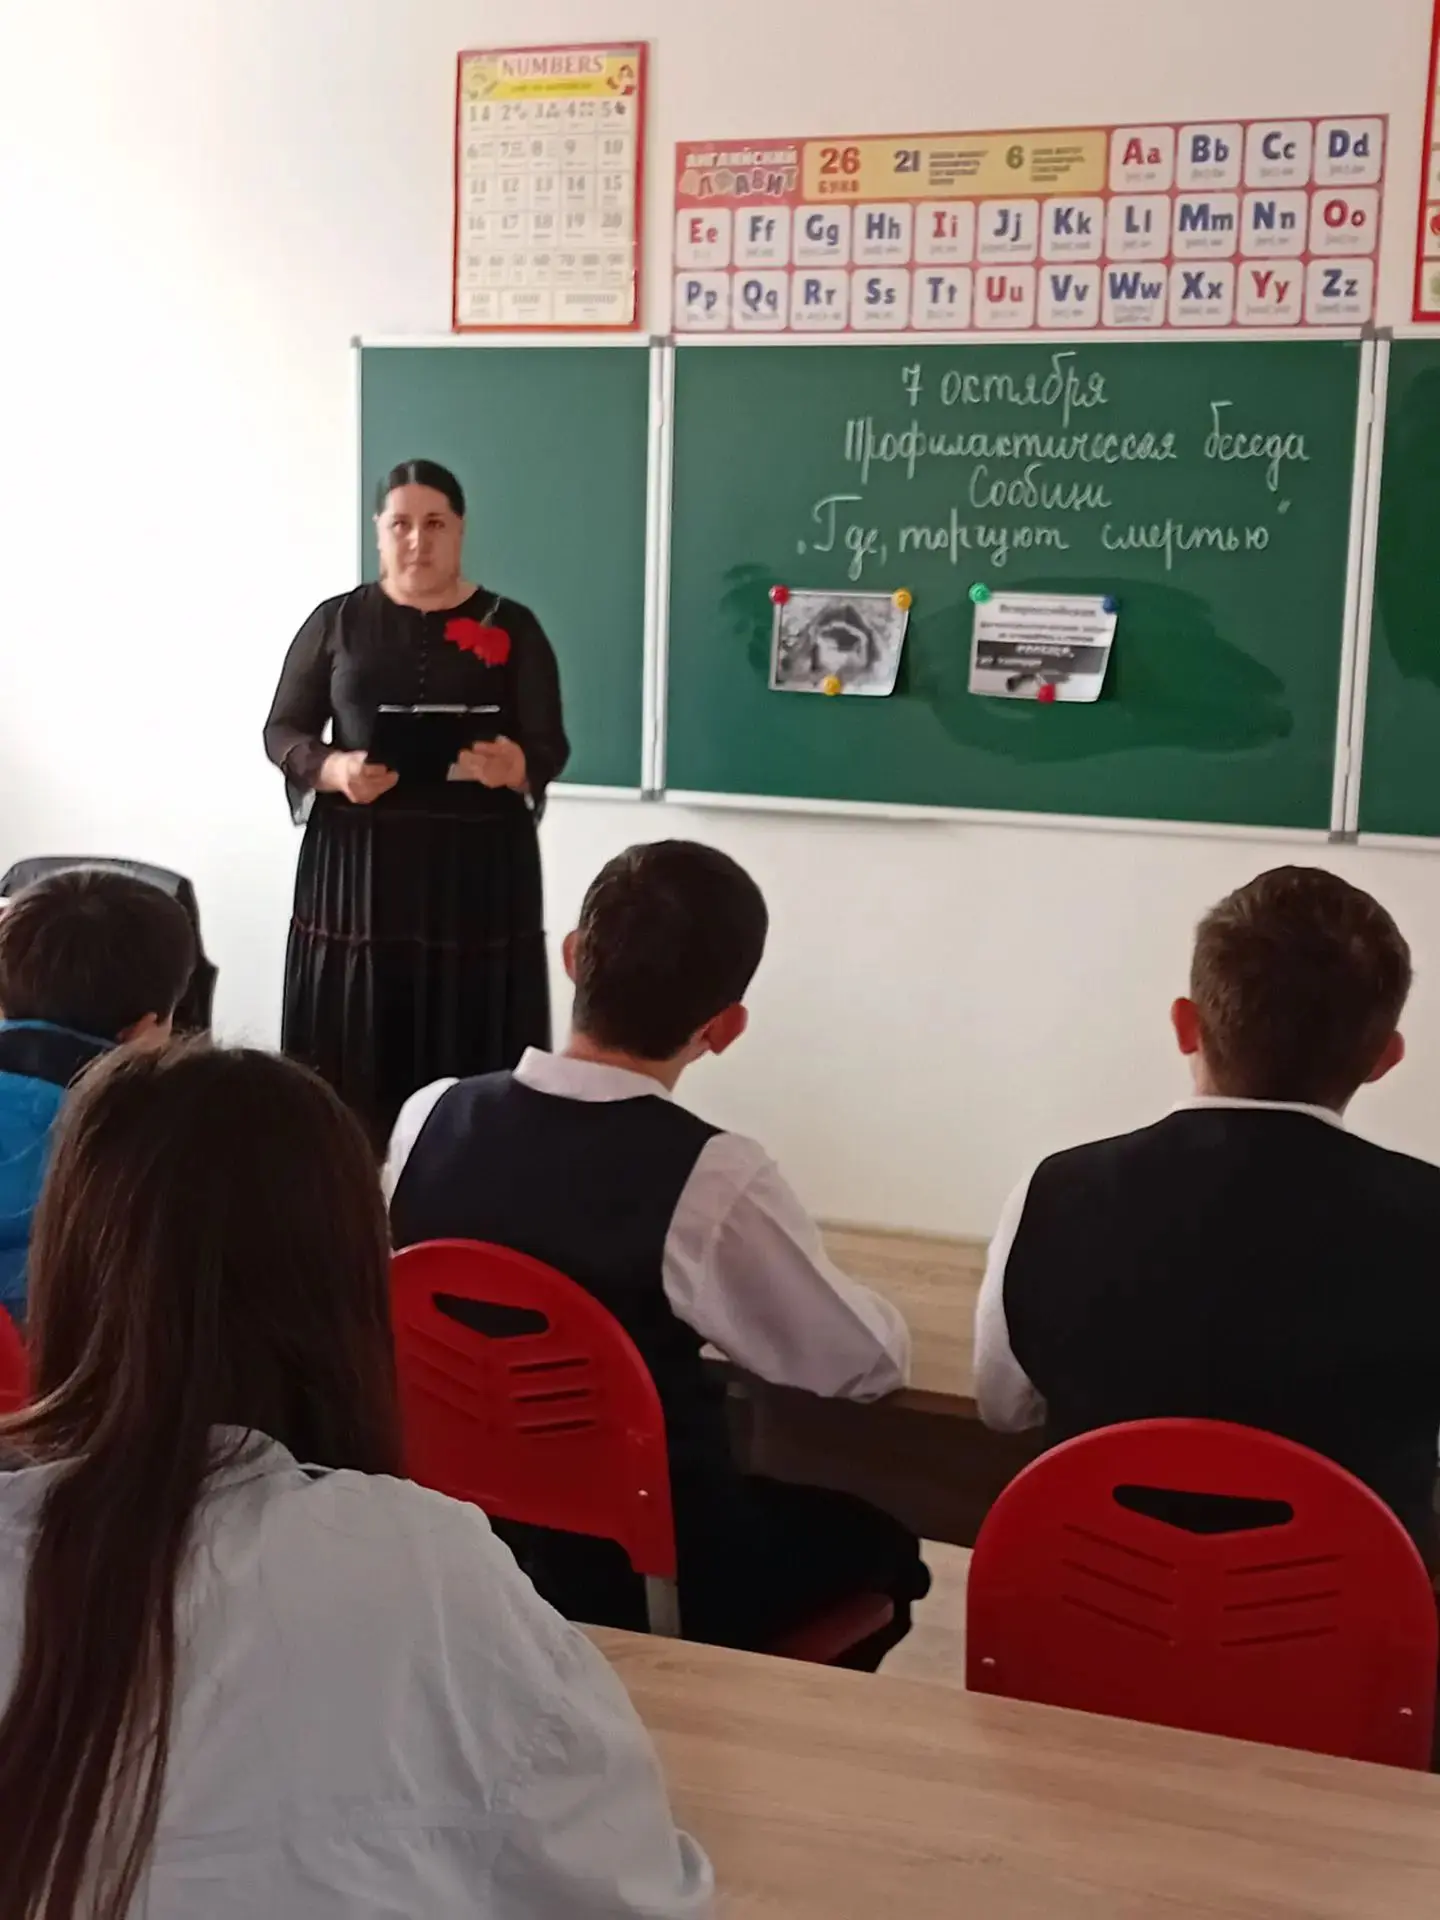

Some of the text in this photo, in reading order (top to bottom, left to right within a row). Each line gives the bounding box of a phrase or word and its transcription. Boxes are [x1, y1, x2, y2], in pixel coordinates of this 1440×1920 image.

[502, 55, 603, 78] NUMBERS
[500, 104, 511, 120] 2
[565, 101, 576, 118] 4
[601, 101, 612, 117] 5
[1005, 145, 1024, 169] 6
[1122, 137, 1162, 166] Aa
[1191, 134, 1230, 164] Bb
[1262, 131, 1296, 160] Cc
[1328, 129, 1370, 158] Dd
[820, 147, 861, 175] 26
[893, 150, 921, 172] 21
[866, 212, 900, 240] Hh
[932, 211, 958, 239] Ii
[993, 209, 1022, 242] Jj
[1053, 206, 1091, 236] Kk
[1124, 205, 1152, 233] Ll
[1178, 203, 1233, 232] Mm
[1252, 201, 1296, 230] Nn
[1323, 198, 1366, 228] Oo
[689, 217, 718, 244] Ee
[749, 215, 775, 242] Ff
[806, 213, 839, 246] Gg
[687, 279, 718, 311] Pp
[743, 279, 779, 312] Qq
[804, 278, 837, 305] Rr
[865, 278, 896, 305] Ss
[926, 277, 957, 304] Tt
[986, 275, 1023, 303] Uu
[1050, 274, 1090, 302] Vv
[1109, 272, 1163, 300] Ww
[1181, 271, 1224, 300] Xx
[1251, 270, 1291, 304] Yy
[1322, 269, 1358, 298] Zz
[901, 351, 1108, 428] 7 октября
[1203, 401, 1311, 492] беседа
[898, 508, 1069, 567] торгуют
